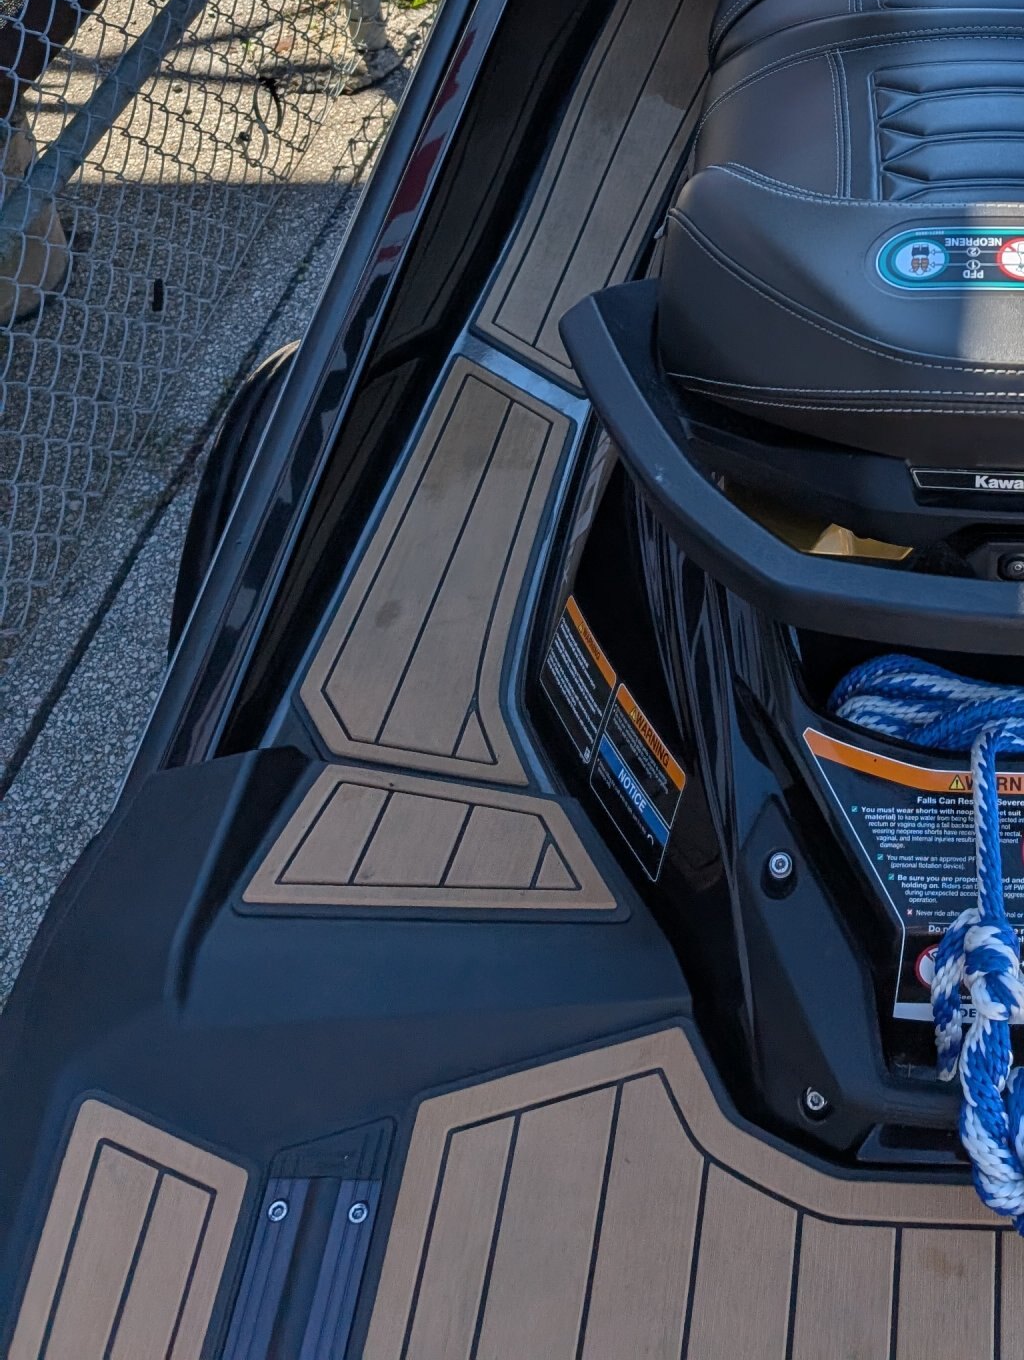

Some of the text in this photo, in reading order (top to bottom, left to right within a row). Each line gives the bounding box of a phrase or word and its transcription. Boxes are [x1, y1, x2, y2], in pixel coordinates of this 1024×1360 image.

[944, 237, 1003, 247] NEOPRENE
[962, 269, 984, 279] PFD
[635, 710, 670, 769] WARNING
[617, 767, 648, 814] NOTICE
[917, 796, 937, 804] Falls
[939, 797, 956, 805] Can
[957, 797, 974, 805] Res
[997, 799, 1024, 807] Severe
[901, 881, 927, 889] holding
[928, 925, 941, 933] Do
